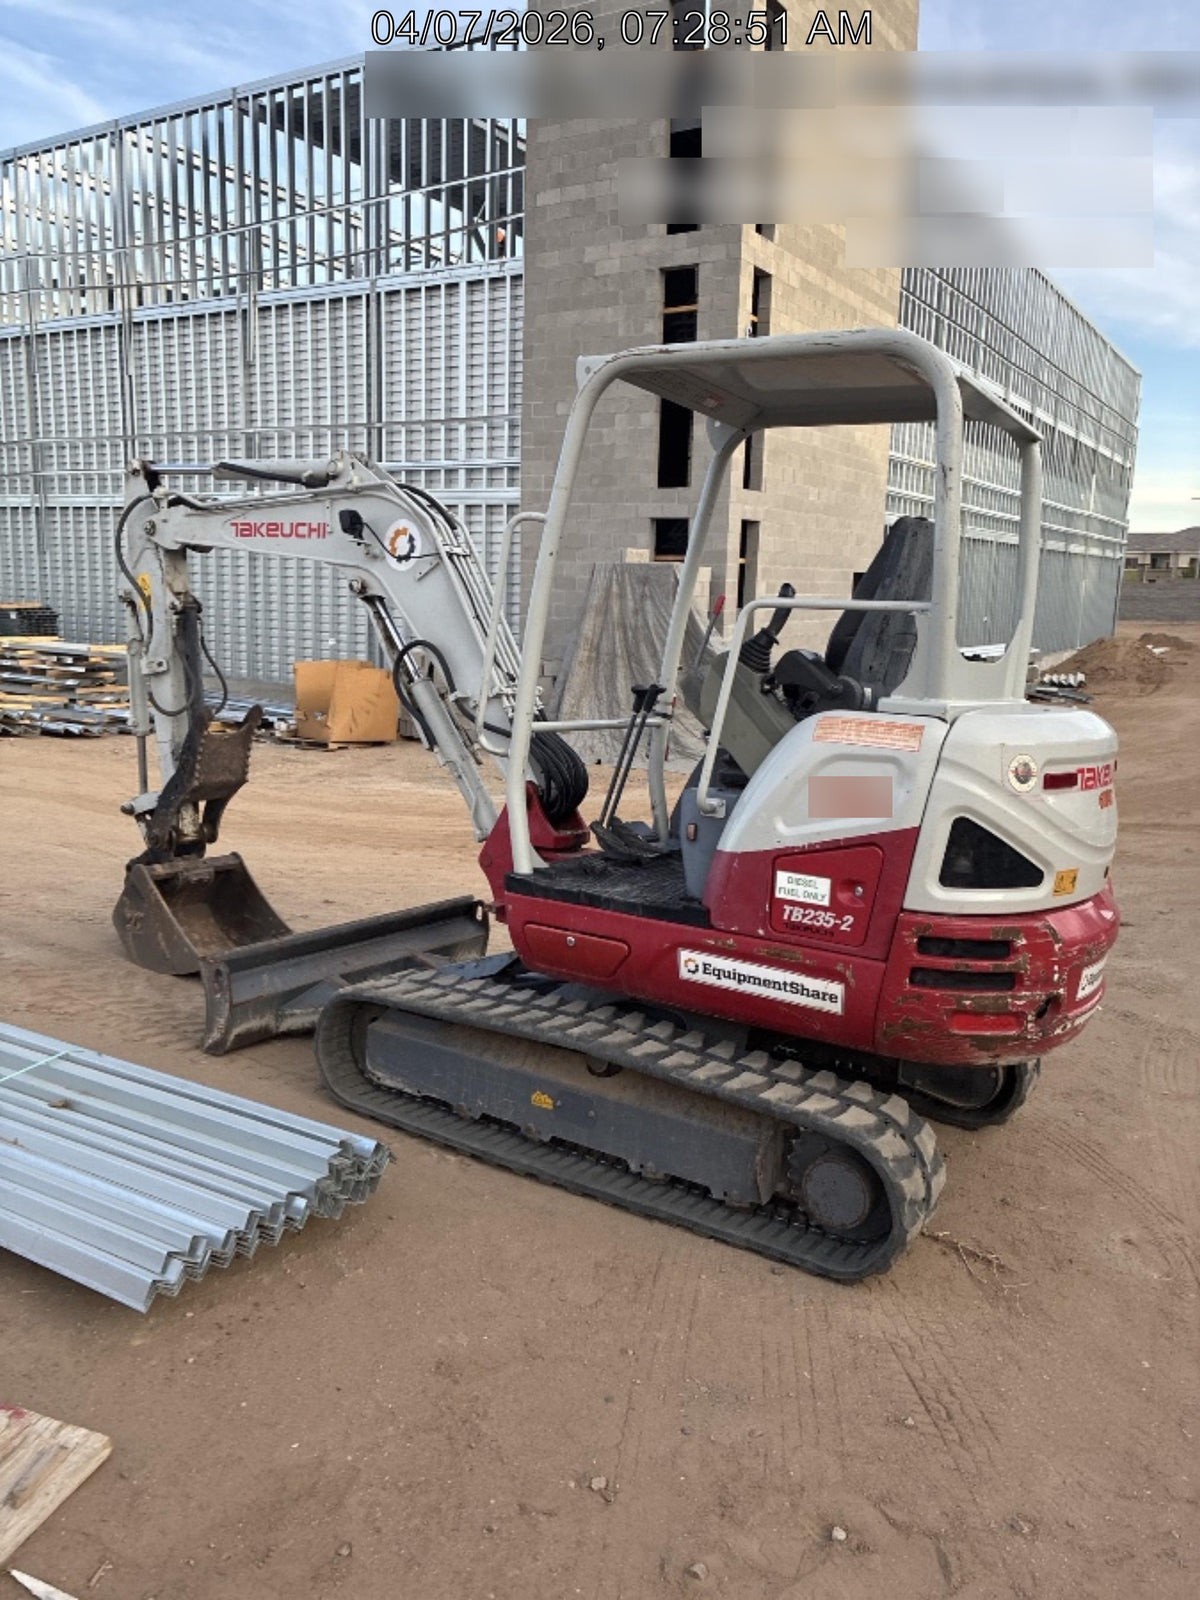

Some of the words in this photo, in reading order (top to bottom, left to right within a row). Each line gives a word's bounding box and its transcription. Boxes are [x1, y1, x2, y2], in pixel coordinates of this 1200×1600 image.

[787, 876, 818, 889] DIESEL
[779, 887, 800, 898] FUEL
[803, 891, 827, 902] ONLY
[783, 904, 854, 932] TB235-2
[702, 962, 839, 1004] EquipmentShare
